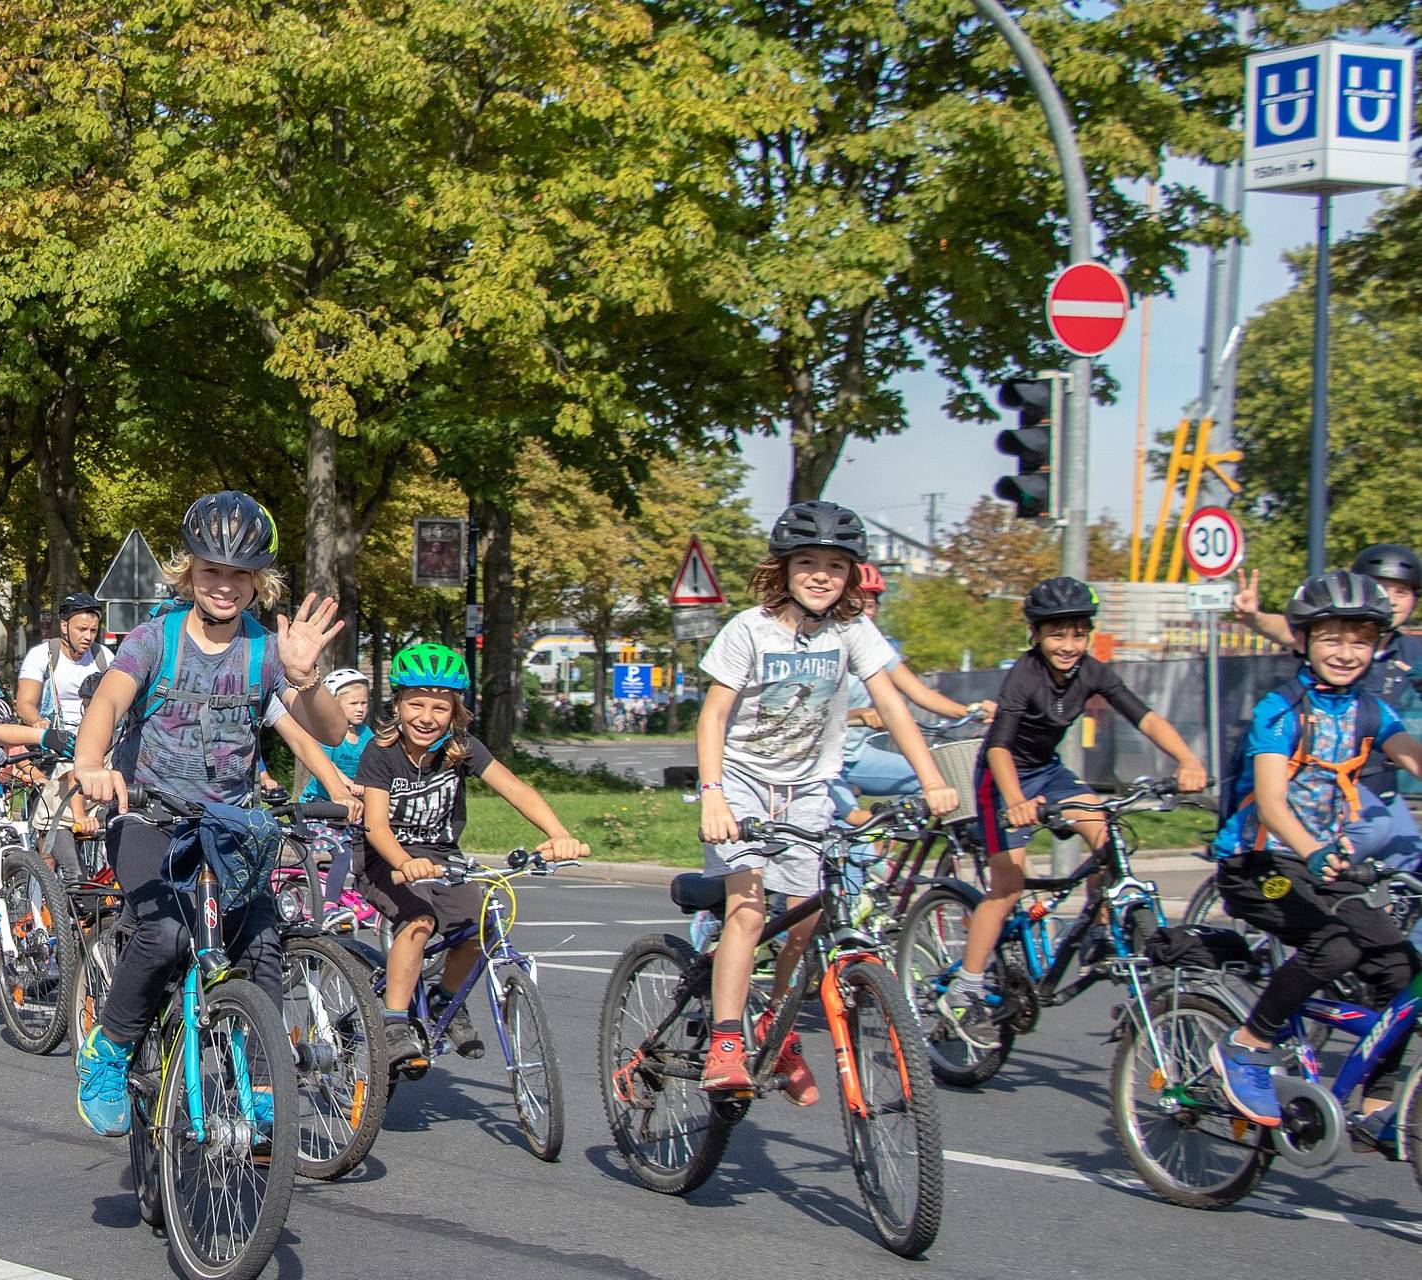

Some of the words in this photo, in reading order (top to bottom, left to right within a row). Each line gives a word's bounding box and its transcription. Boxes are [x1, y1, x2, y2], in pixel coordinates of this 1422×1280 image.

[1195, 527, 1228, 557] 30
[768, 660, 791, 682] I'D
[795, 658, 838, 680] RATHER
[410, 781, 426, 790] THE
